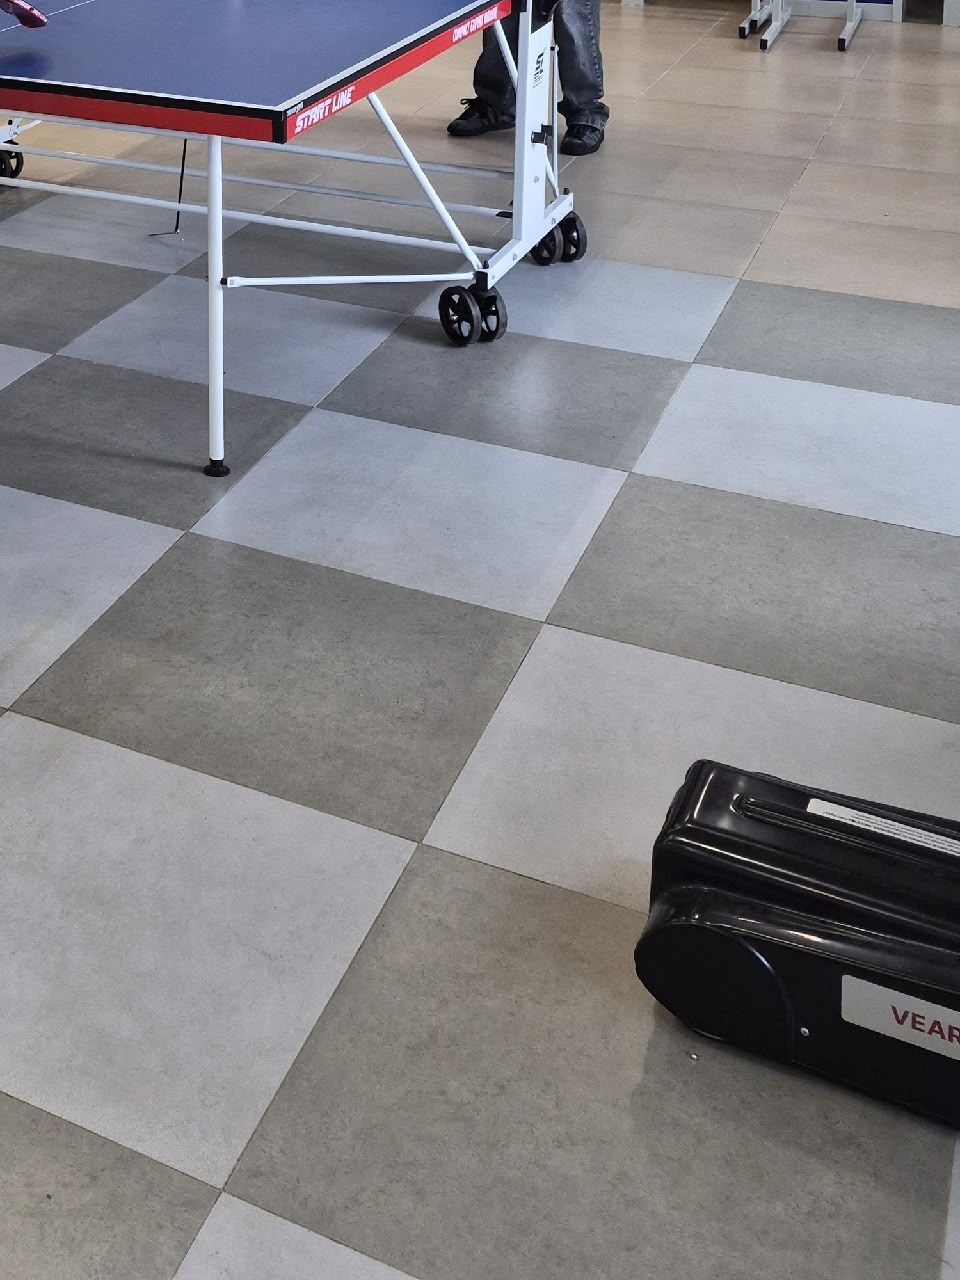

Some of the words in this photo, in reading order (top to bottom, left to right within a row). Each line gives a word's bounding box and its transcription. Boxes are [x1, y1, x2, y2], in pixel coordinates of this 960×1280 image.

[294, 98, 333, 135] START
[331, 86, 355, 114] LINE
[891, 1004, 960, 1046] VEAR
